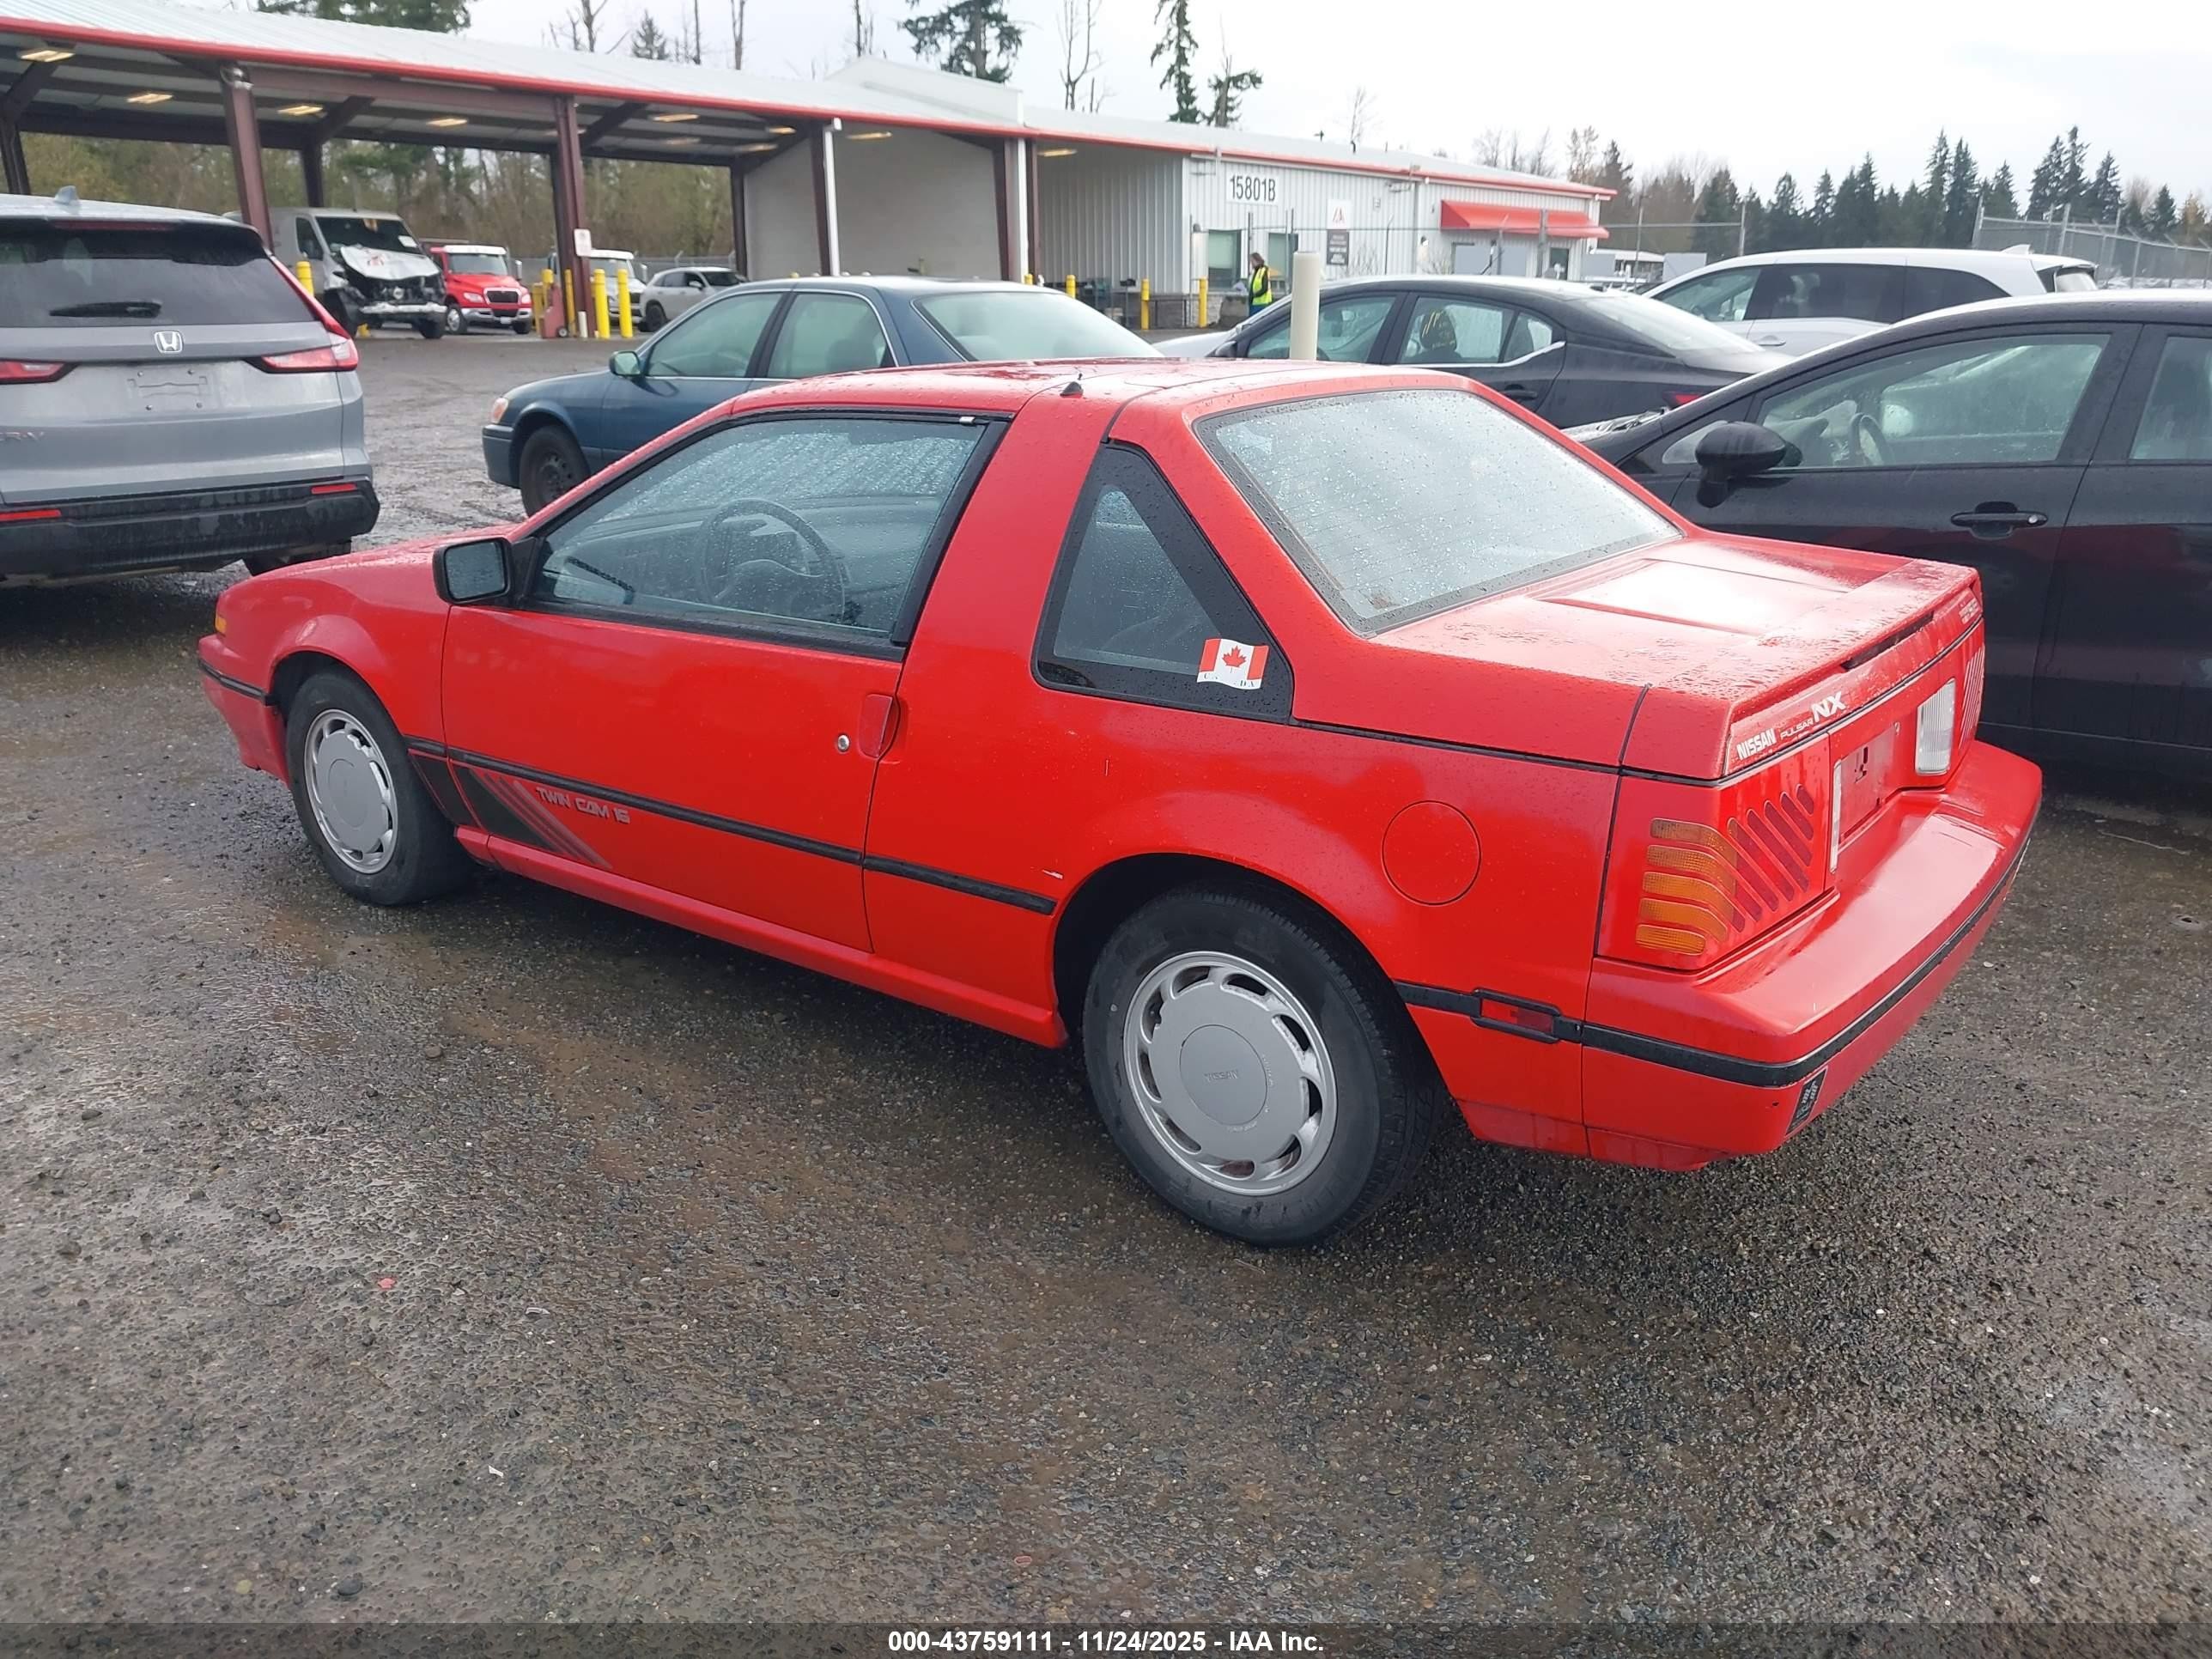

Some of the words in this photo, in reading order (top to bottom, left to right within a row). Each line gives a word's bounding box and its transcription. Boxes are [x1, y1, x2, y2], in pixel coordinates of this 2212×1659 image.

[1230, 174, 1276, 203] 15801B
[1736, 728, 1777, 760] NISSAN
[1780, 717, 1814, 740] PULSAR
[1811, 691, 1846, 723] NX
[535, 787, 571, 809] TWIN
[574, 797, 611, 819] CAM
